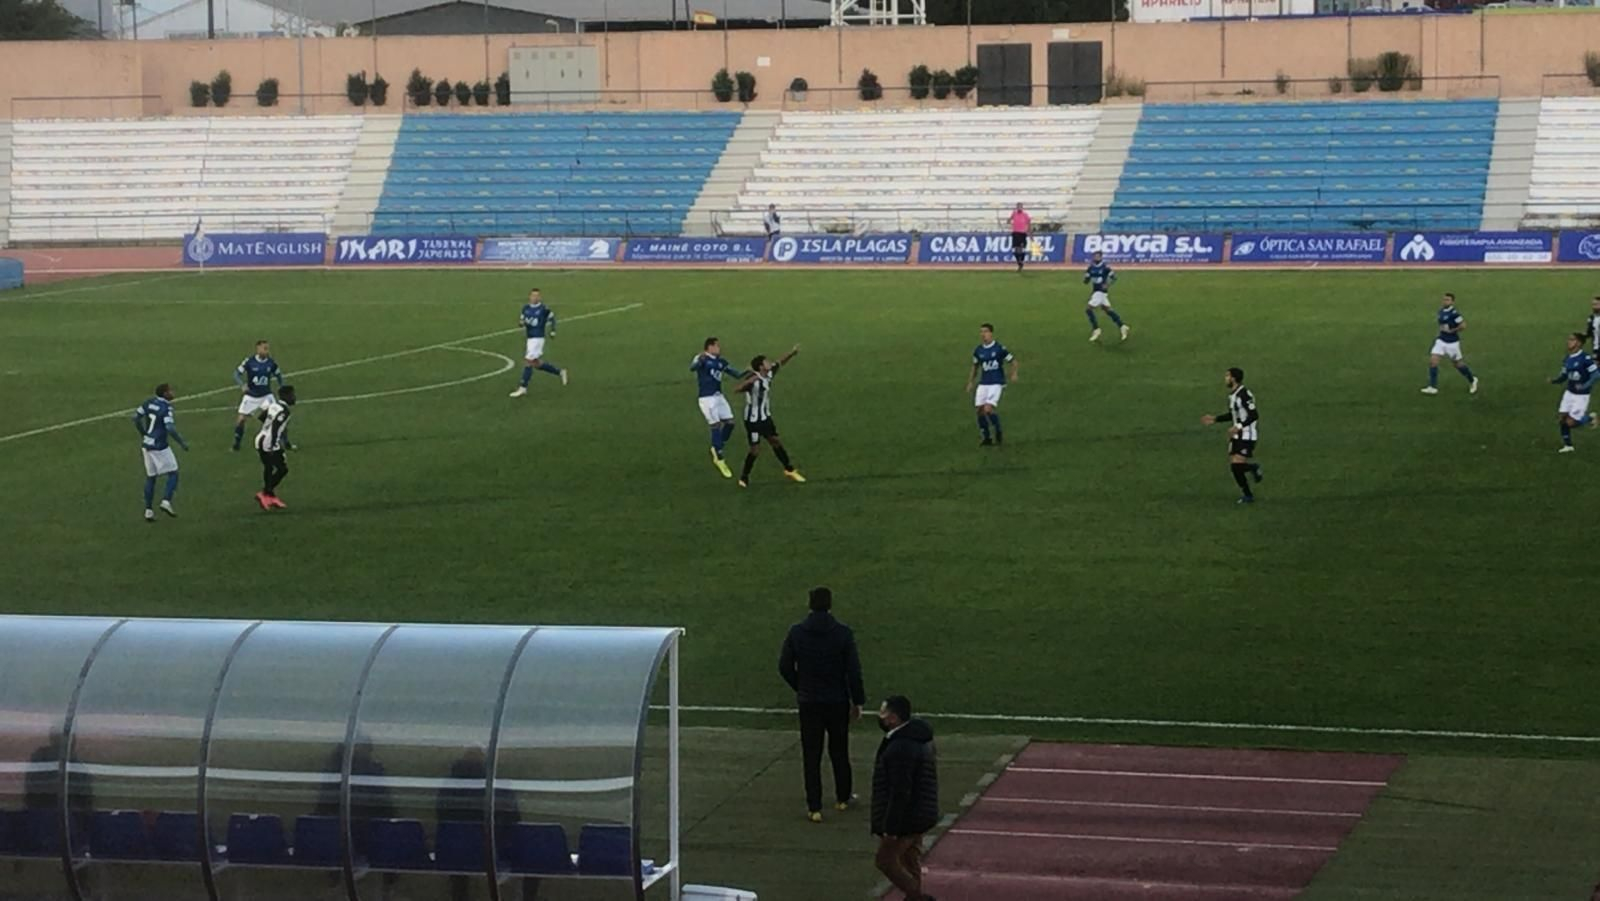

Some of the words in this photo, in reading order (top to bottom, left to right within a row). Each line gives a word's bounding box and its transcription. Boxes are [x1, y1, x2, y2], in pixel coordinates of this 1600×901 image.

[218, 241, 322, 255] MATENGLISH
[694, 243, 728, 252] COTO
[801, 239, 840, 252] ISLA
[845, 239, 907, 253] PLAGAS
[930, 236, 980, 253] CASA
[1259, 236, 1305, 251] ÓPTICA
[1308, 239, 1333, 251] SAN
[1335, 239, 1385, 251] RAFAEL
